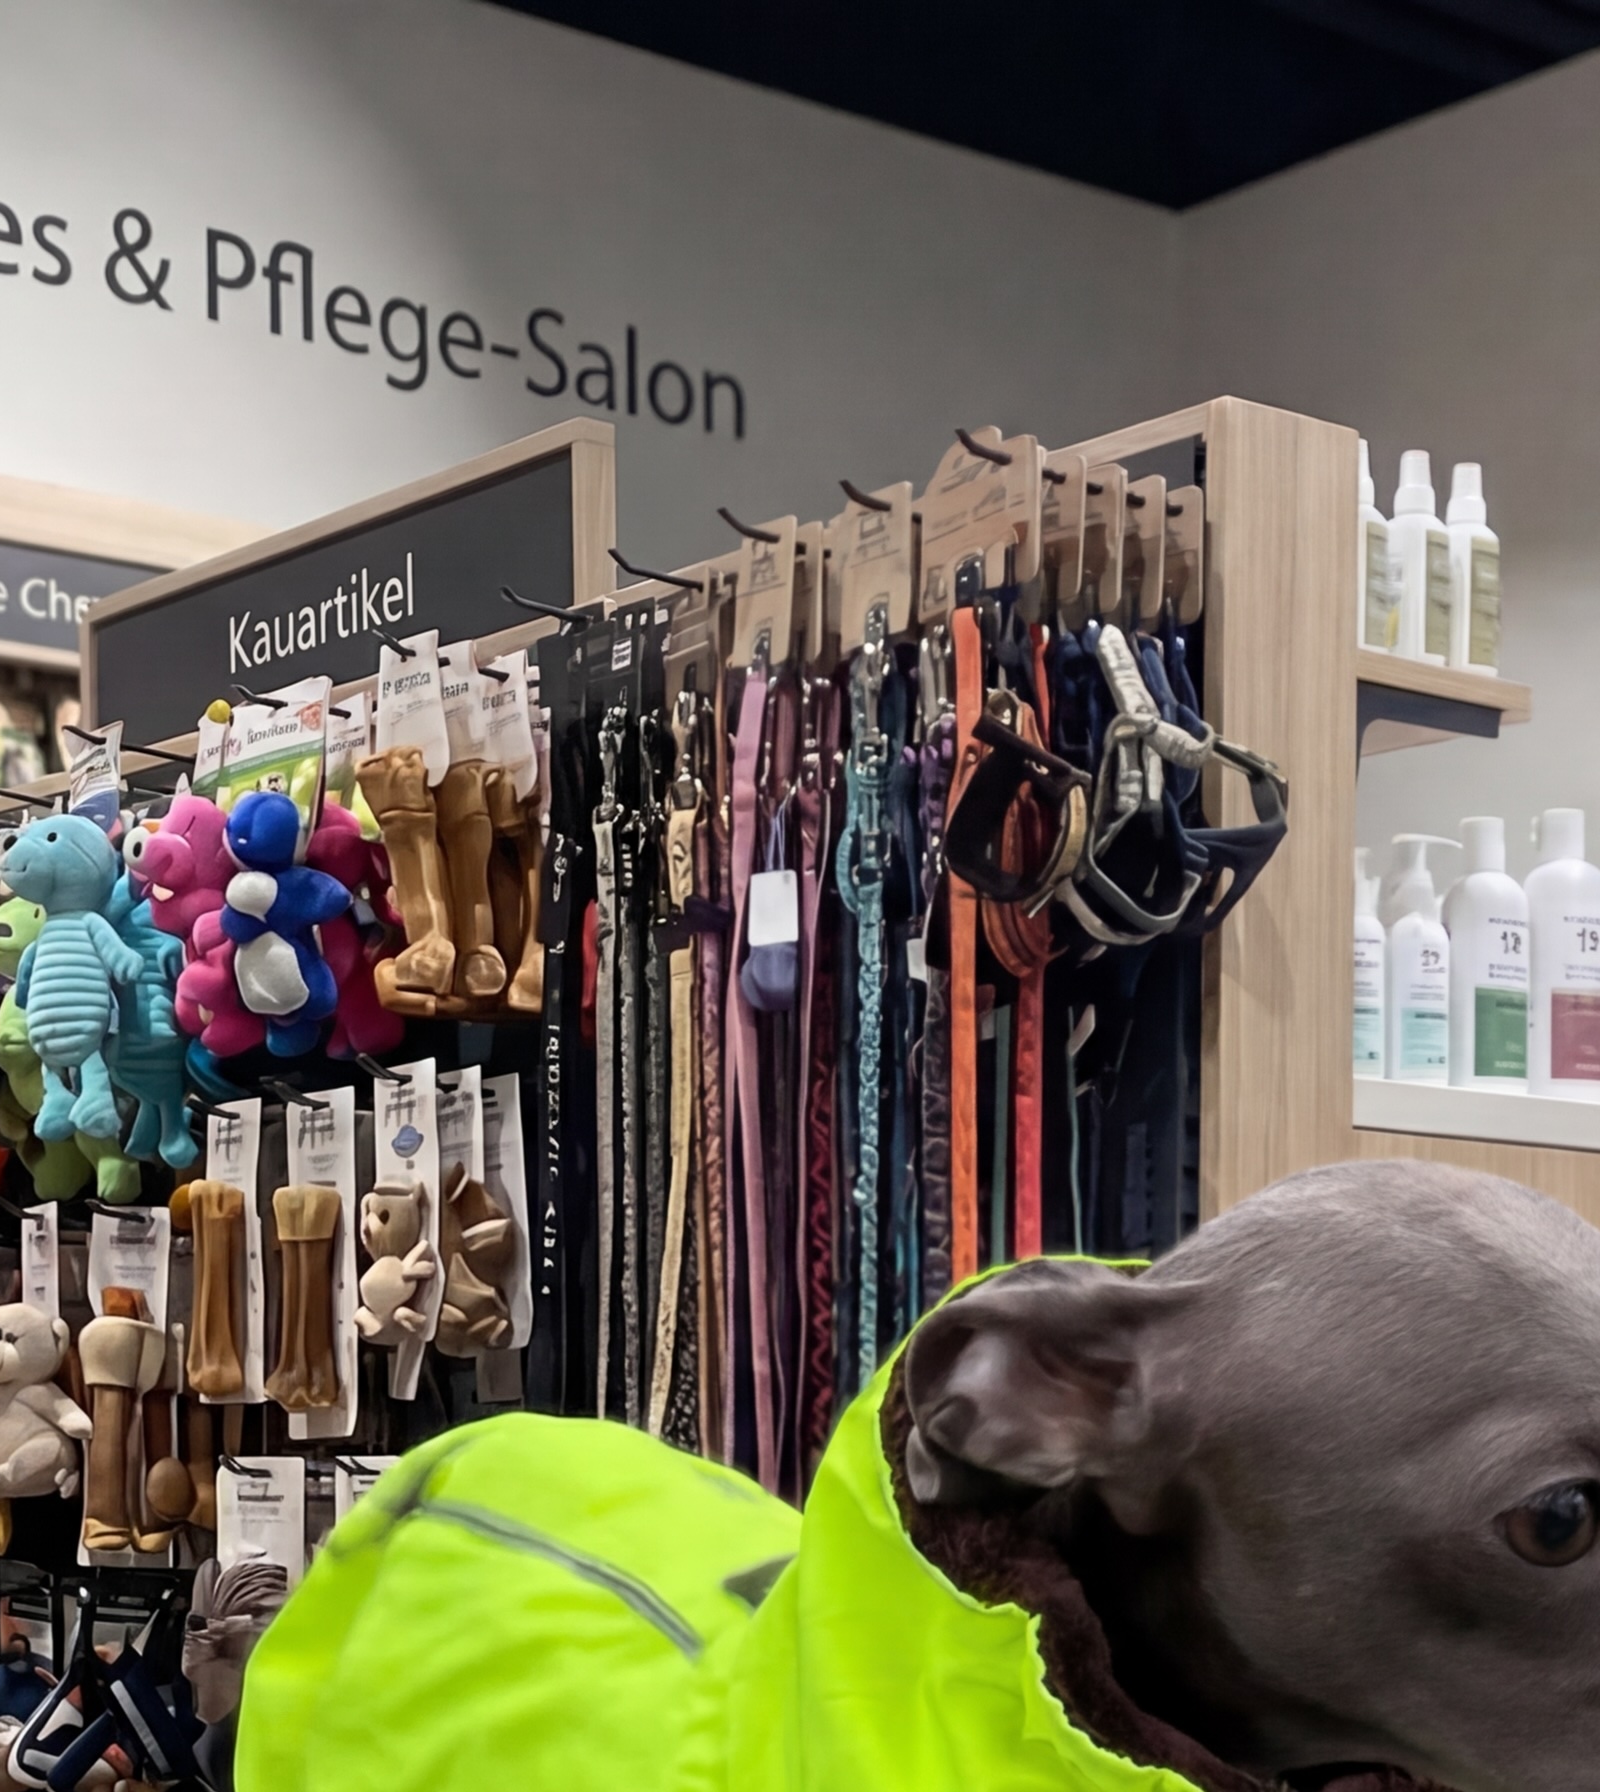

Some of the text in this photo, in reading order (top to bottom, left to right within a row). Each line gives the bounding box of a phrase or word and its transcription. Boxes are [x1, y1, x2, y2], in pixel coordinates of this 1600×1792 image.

[104, 208, 173, 311] &
[206, 227, 746, 439] Pflege-Salon
[19, 577, 100, 624] Che
[229, 551, 414, 675] Kauartikel
